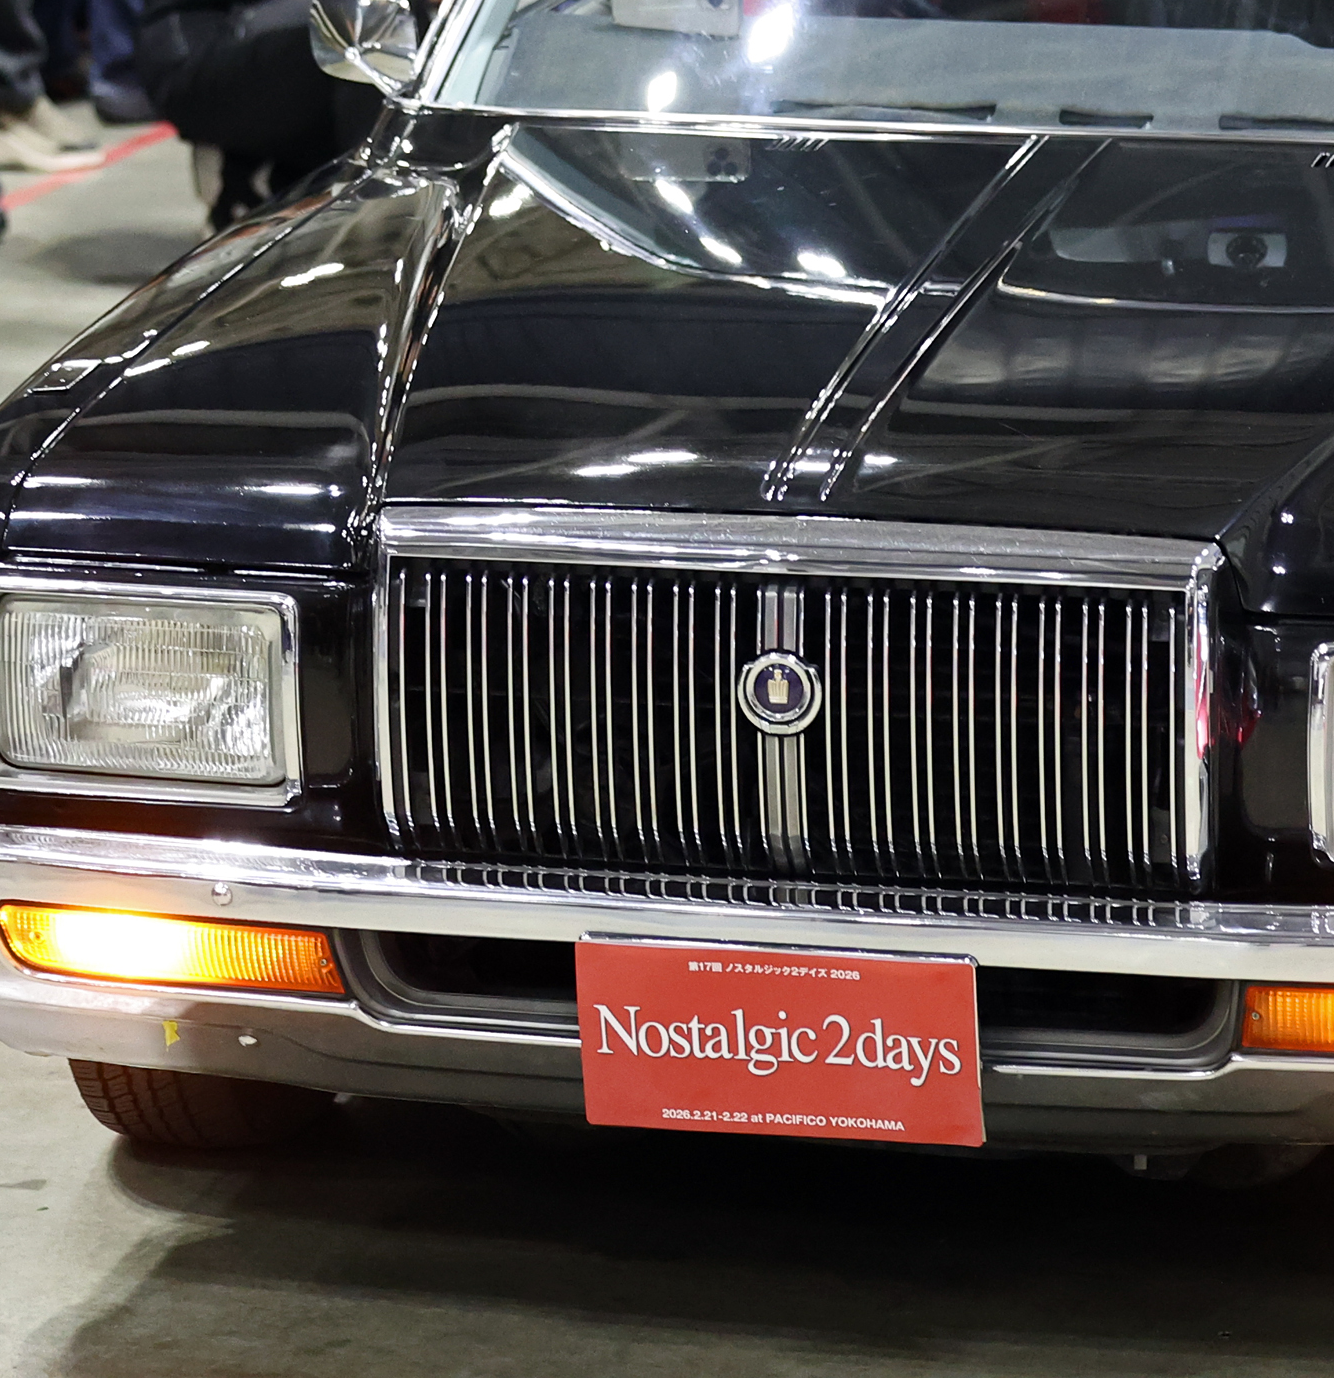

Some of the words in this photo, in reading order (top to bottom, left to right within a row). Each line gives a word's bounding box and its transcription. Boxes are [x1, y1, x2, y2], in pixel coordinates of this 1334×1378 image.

[725, 962, 828, 979] ノスタルジック2デイズ
[830, 968, 861, 981] 2026
[593, 1004, 818, 1076] Nostalgic
[822, 1014, 962, 1087] 2days
[662, 1108, 748, 1123] 2026.2.21-2.22
[750, 1114, 764, 1124] at
[765, 1113, 827, 1127] PACIFICO
[829, 1116, 906, 1131] YOKOHAMA
